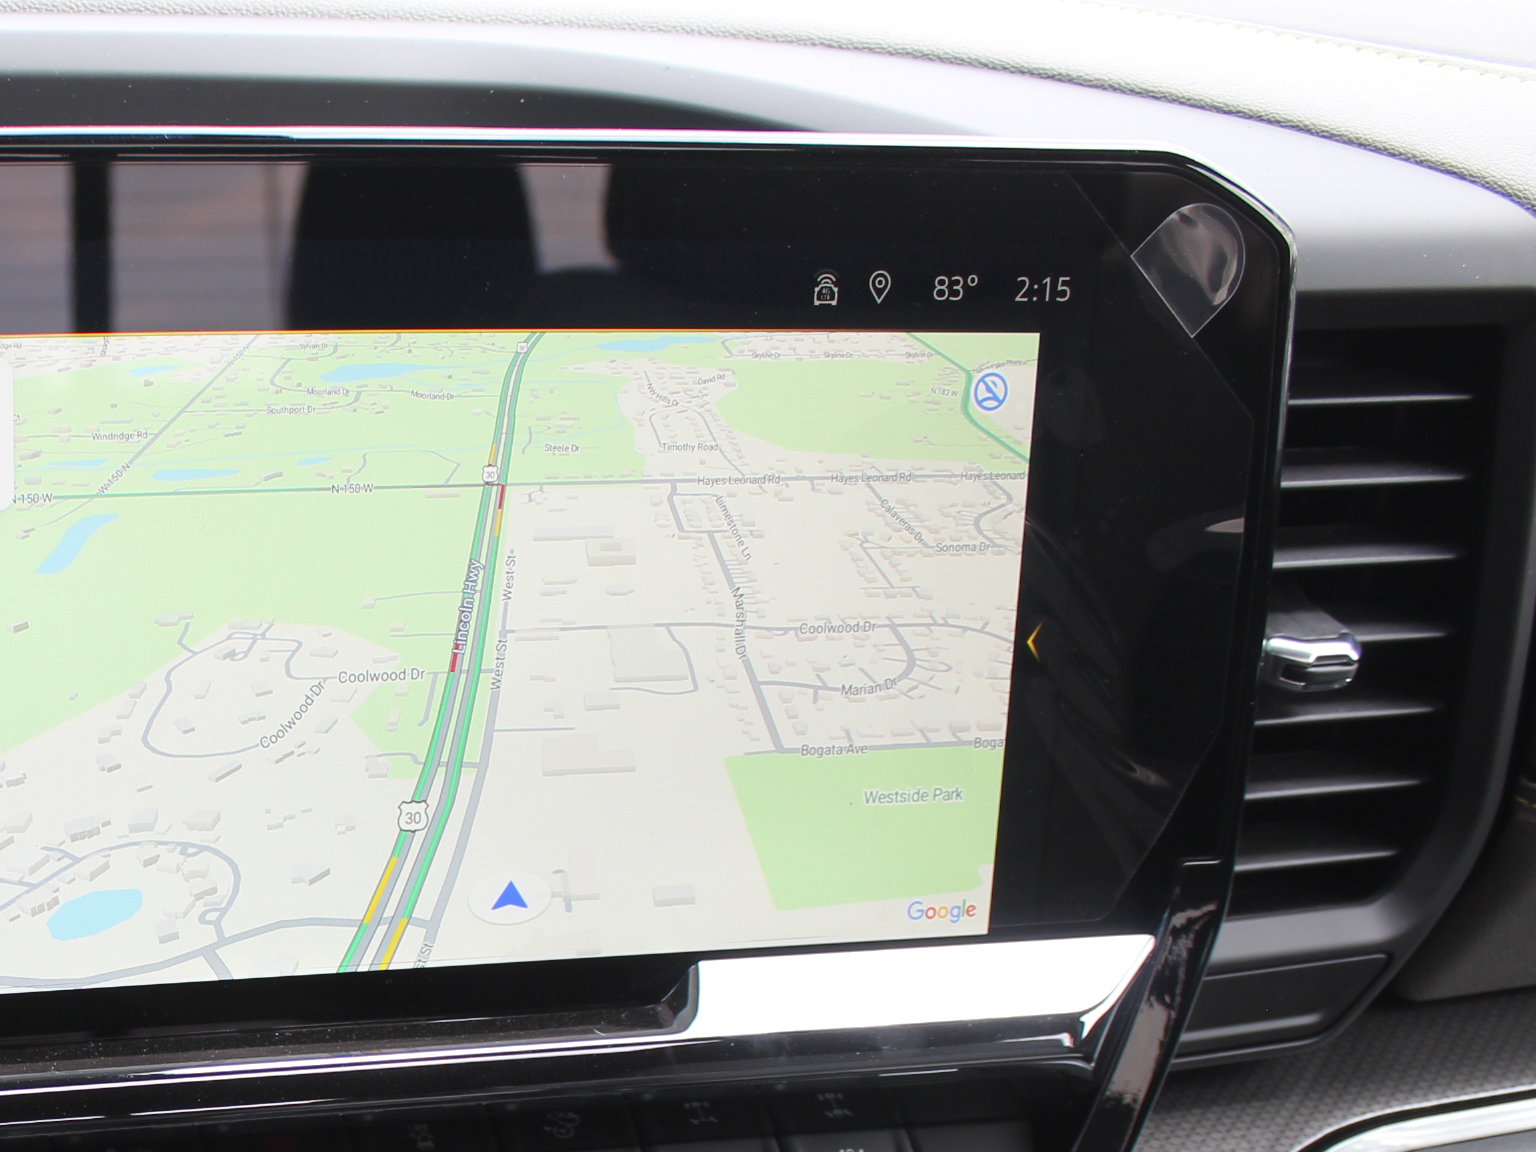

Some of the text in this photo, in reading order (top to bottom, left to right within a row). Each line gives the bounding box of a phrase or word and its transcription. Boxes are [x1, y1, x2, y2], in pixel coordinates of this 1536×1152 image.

[1014, 276, 1072, 302] 2:15
[342, 387, 351, 396] Dr
[266, 406, 316, 416] Southport Dr
[136, 430, 149, 440] Rd
[544, 443, 580, 453] Steele Dr
[662, 443, 719, 452] Timothy Road
[697, 475, 781, 488] Hayes Leonard Rd
[830, 473, 912, 484] Hayes Leonard Rd
[960, 471, 1026, 482] Hayes Leonard
[331, 483, 374, 494] N 150 W
[715, 495, 752, 561] Limestone Ln
[880, 498, 925, 544] Calaveras Dr
[935, 542, 991, 552] Sonoma Dr
[502, 554, 516, 601] West St
[452, 558, 485, 654] Lincoln Hwy
[731, 587, 747, 659] Marshall Dr
[799, 622, 876, 635] Coolwood Dr
[491, 638, 508, 690] West St
[337, 668, 426, 684] Coolwood Dr
[840, 677, 898, 696] Marian Dr
[259, 680, 326, 749] Coolwood Dr
[800, 744, 868, 758] Bogata Ave
[864, 787, 963, 805] Westside Park
[404, 812, 422, 825] 30
[906, 899, 977, 923] Google
